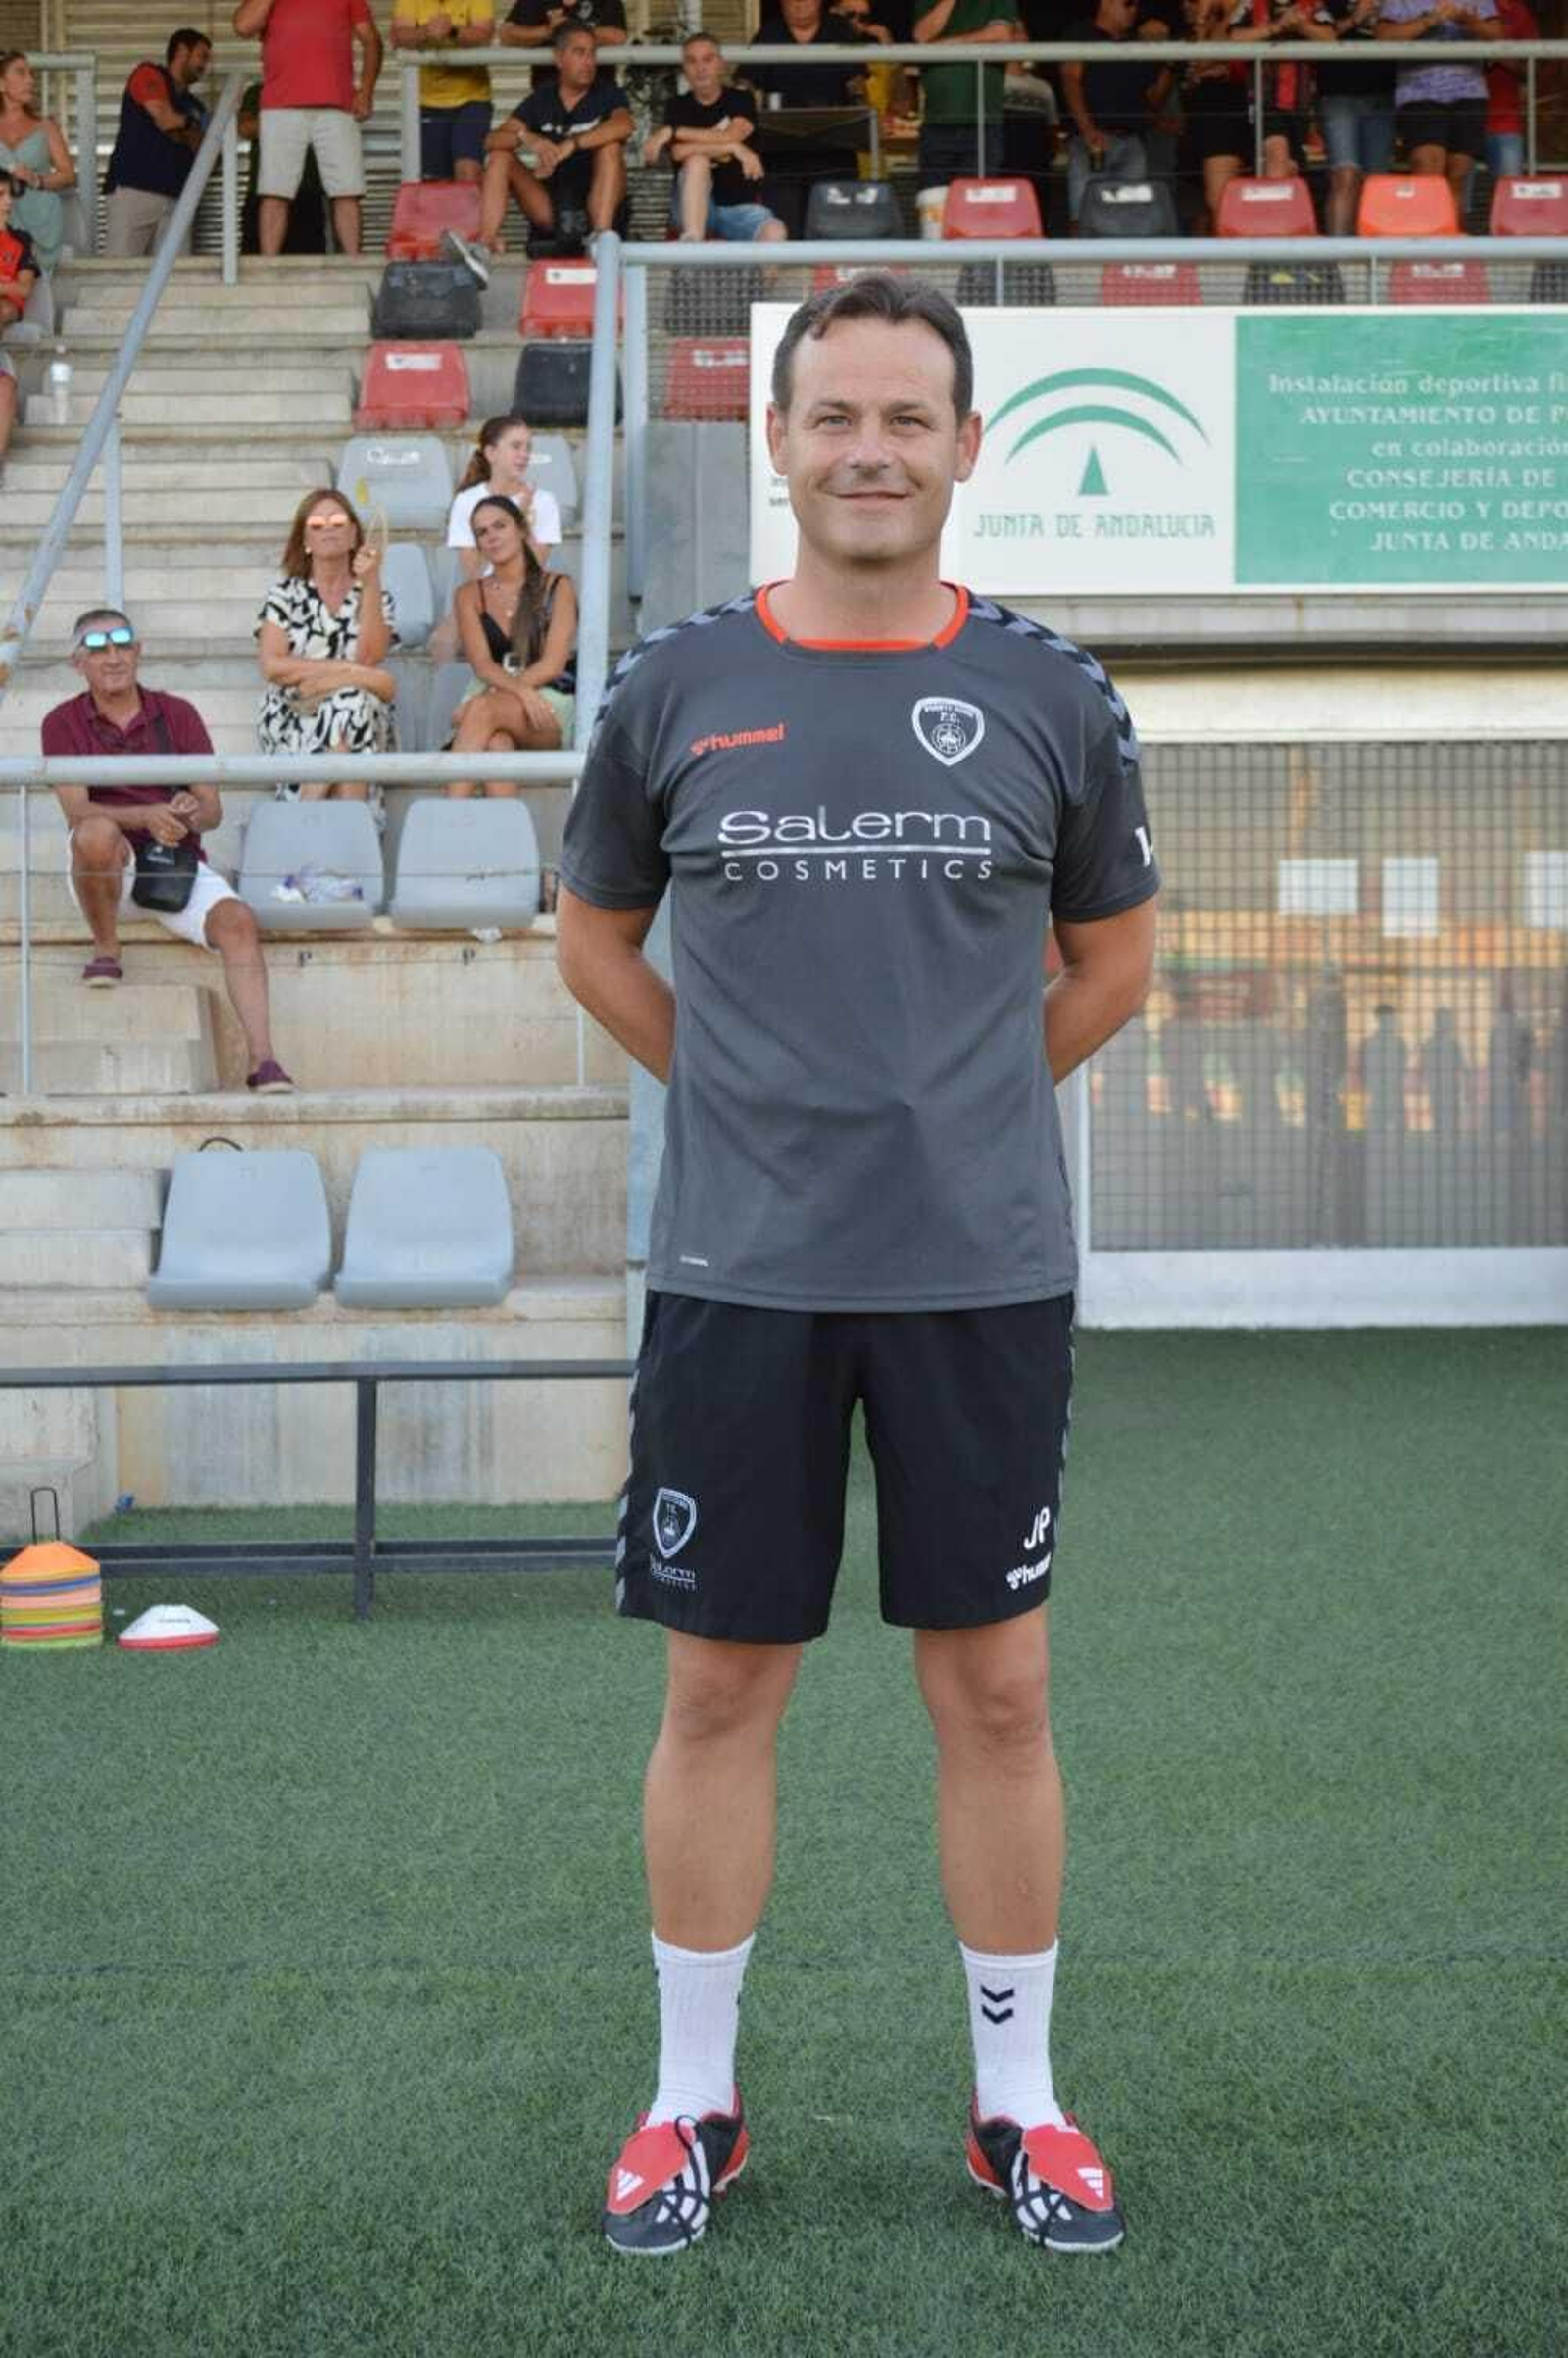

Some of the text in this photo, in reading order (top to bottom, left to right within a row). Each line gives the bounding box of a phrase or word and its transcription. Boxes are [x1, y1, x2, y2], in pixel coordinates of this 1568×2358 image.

[1418, 372, 1540, 398] deportiva
[1300, 405, 1496, 424] AYUNTAMIENTO
[1507, 405, 1540, 424] DE
[1371, 440, 1402, 458] en
[1523, 468, 1556, 488] DE
[1329, 501, 1465, 520] COMERCIO
[1475, 501, 1492, 519] Y
[974, 513, 1044, 538] JUNTA
[1056, 513, 1083, 538] DE
[1370, 531, 1450, 551] JUNTA
[1460, 531, 1493, 551] DE
[710, 722, 784, 752] hummel
[718, 806, 991, 844] Salerm
[725, 859, 993, 881] COSMETICS
[1023, 1506, 1051, 1549] JP
